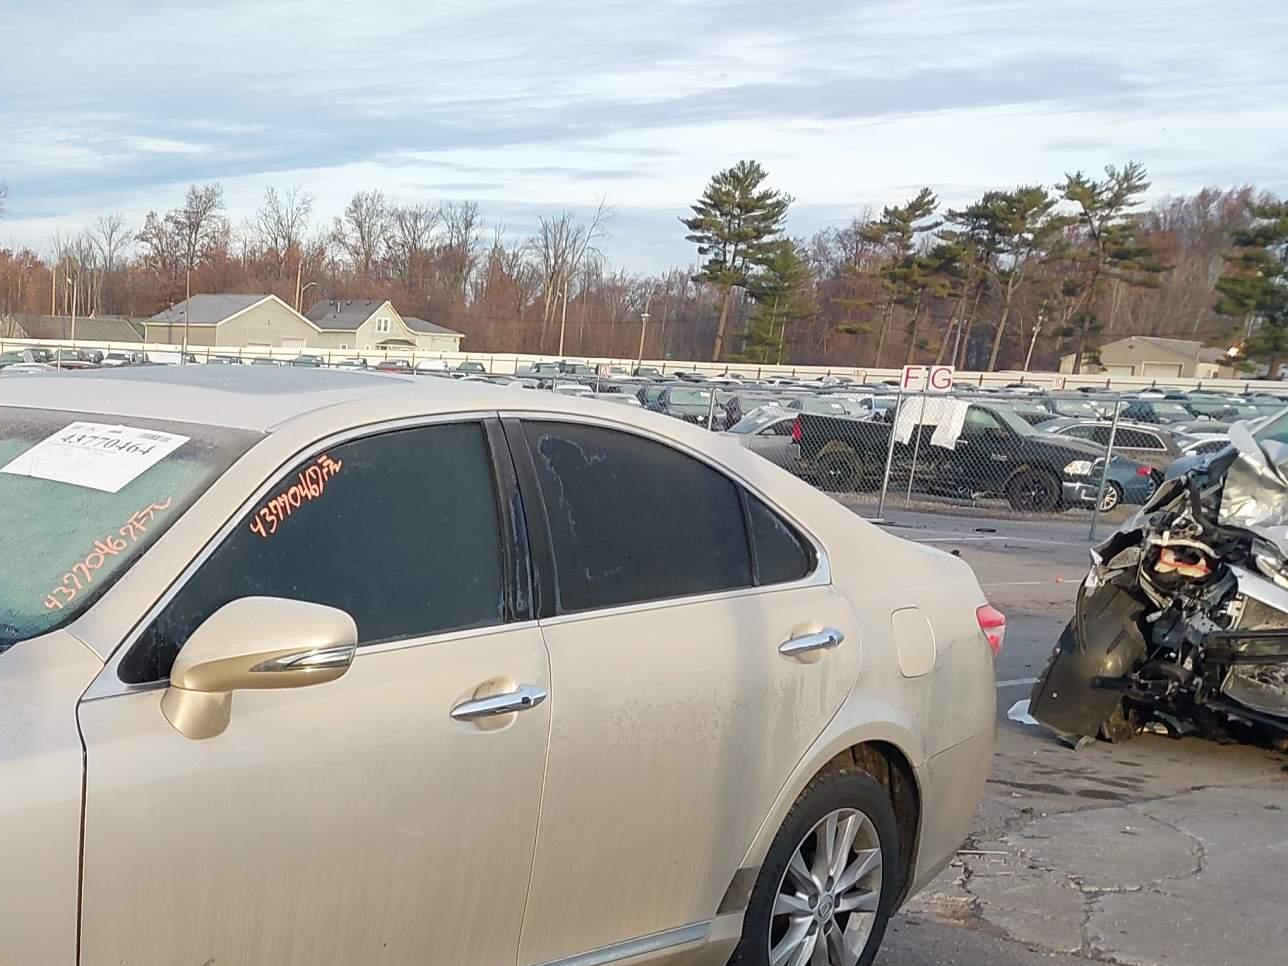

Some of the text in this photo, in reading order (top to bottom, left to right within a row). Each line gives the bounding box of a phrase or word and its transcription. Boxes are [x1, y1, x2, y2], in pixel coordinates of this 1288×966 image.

[903, 366, 953, 390] F G
[59, 433, 157, 456] 43770464
